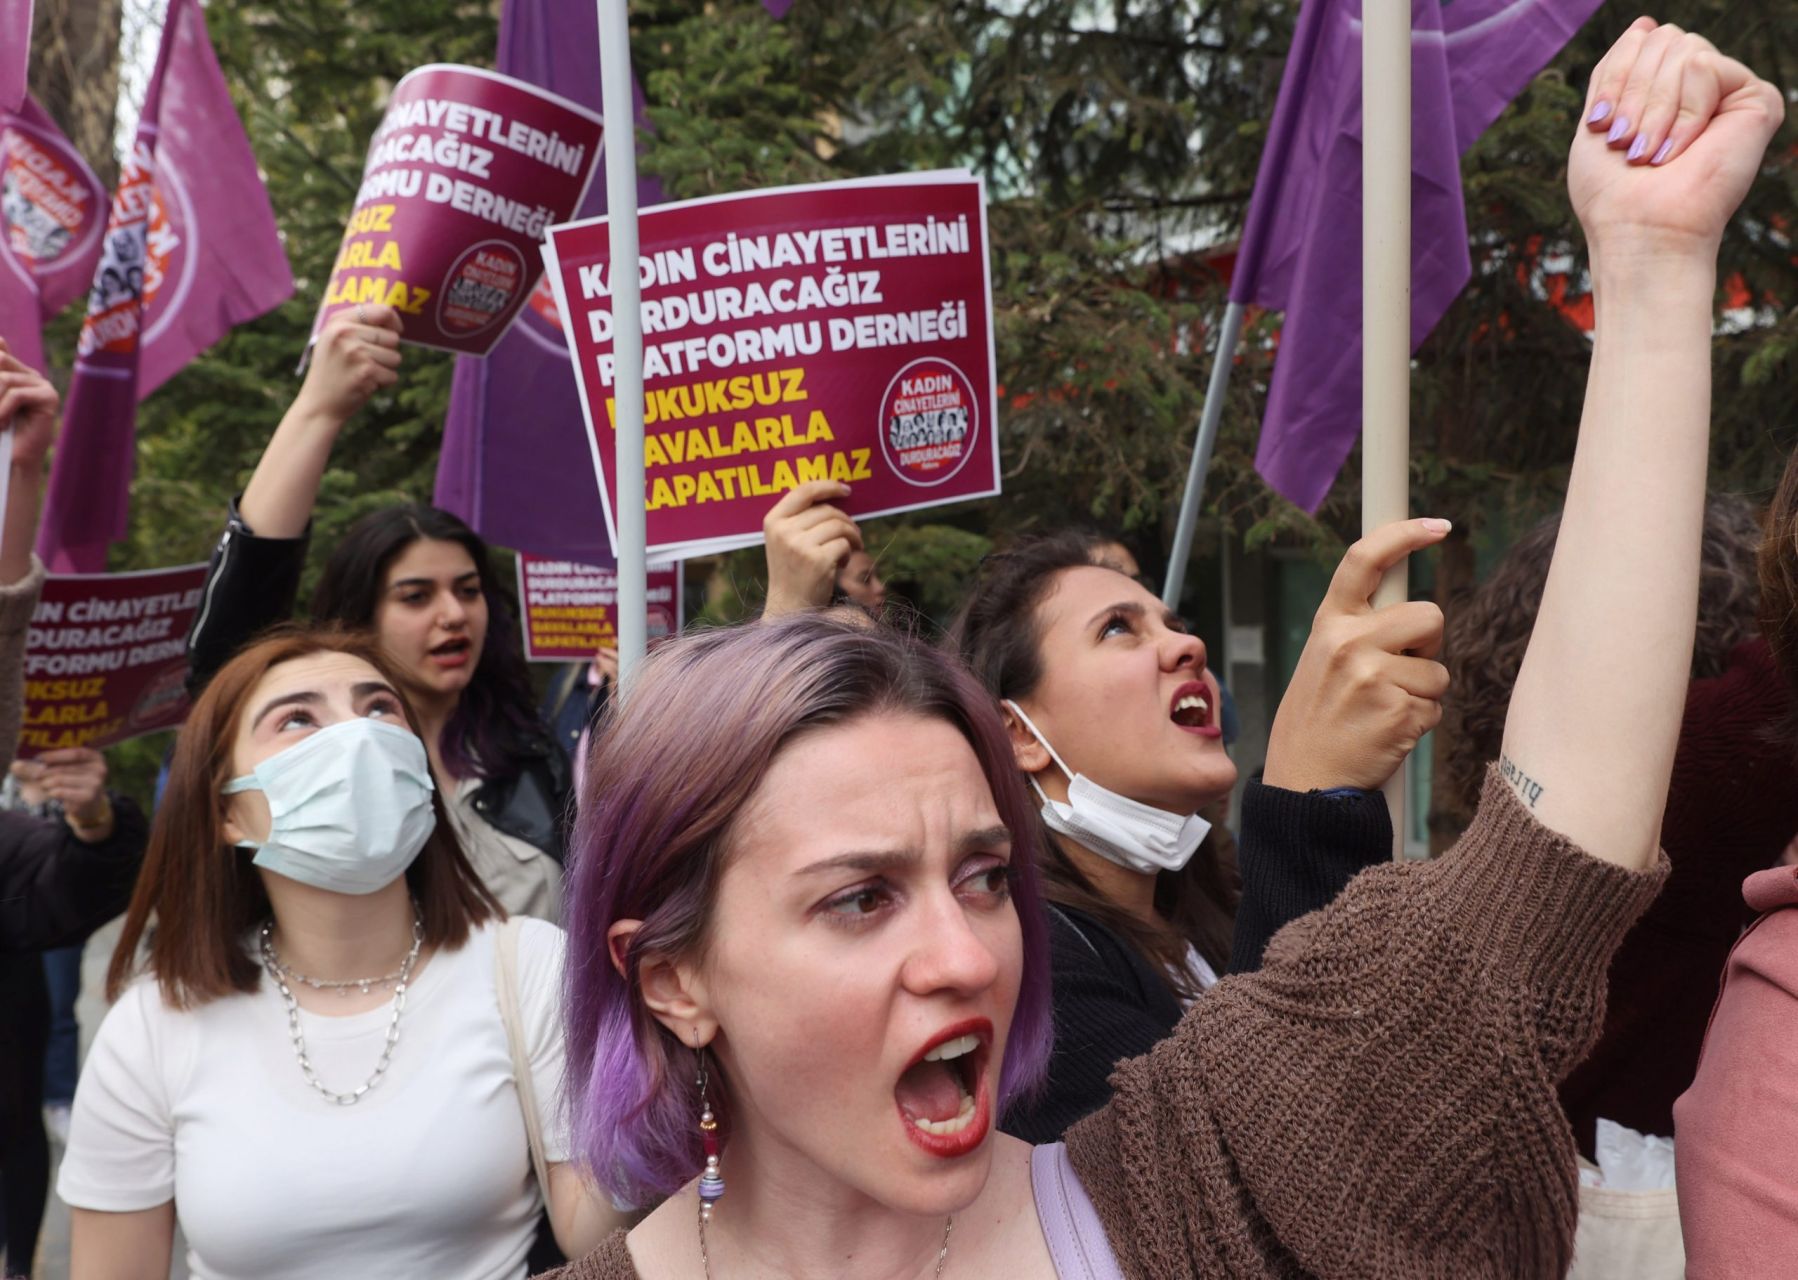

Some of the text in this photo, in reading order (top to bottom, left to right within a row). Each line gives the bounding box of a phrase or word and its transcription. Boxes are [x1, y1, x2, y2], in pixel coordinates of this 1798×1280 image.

[578, 248, 696, 300] KDIN
[702, 214, 970, 273] CİNAYETLERİNİ
[587, 267, 883, 343] DRDURACAĞIZ
[596, 300, 968, 386] PATFORMU DERNEĞİ
[901, 374, 953, 397] KADIN
[644, 411, 835, 468] AVALARLA
[644, 448, 872, 511] APATILAMAZ
